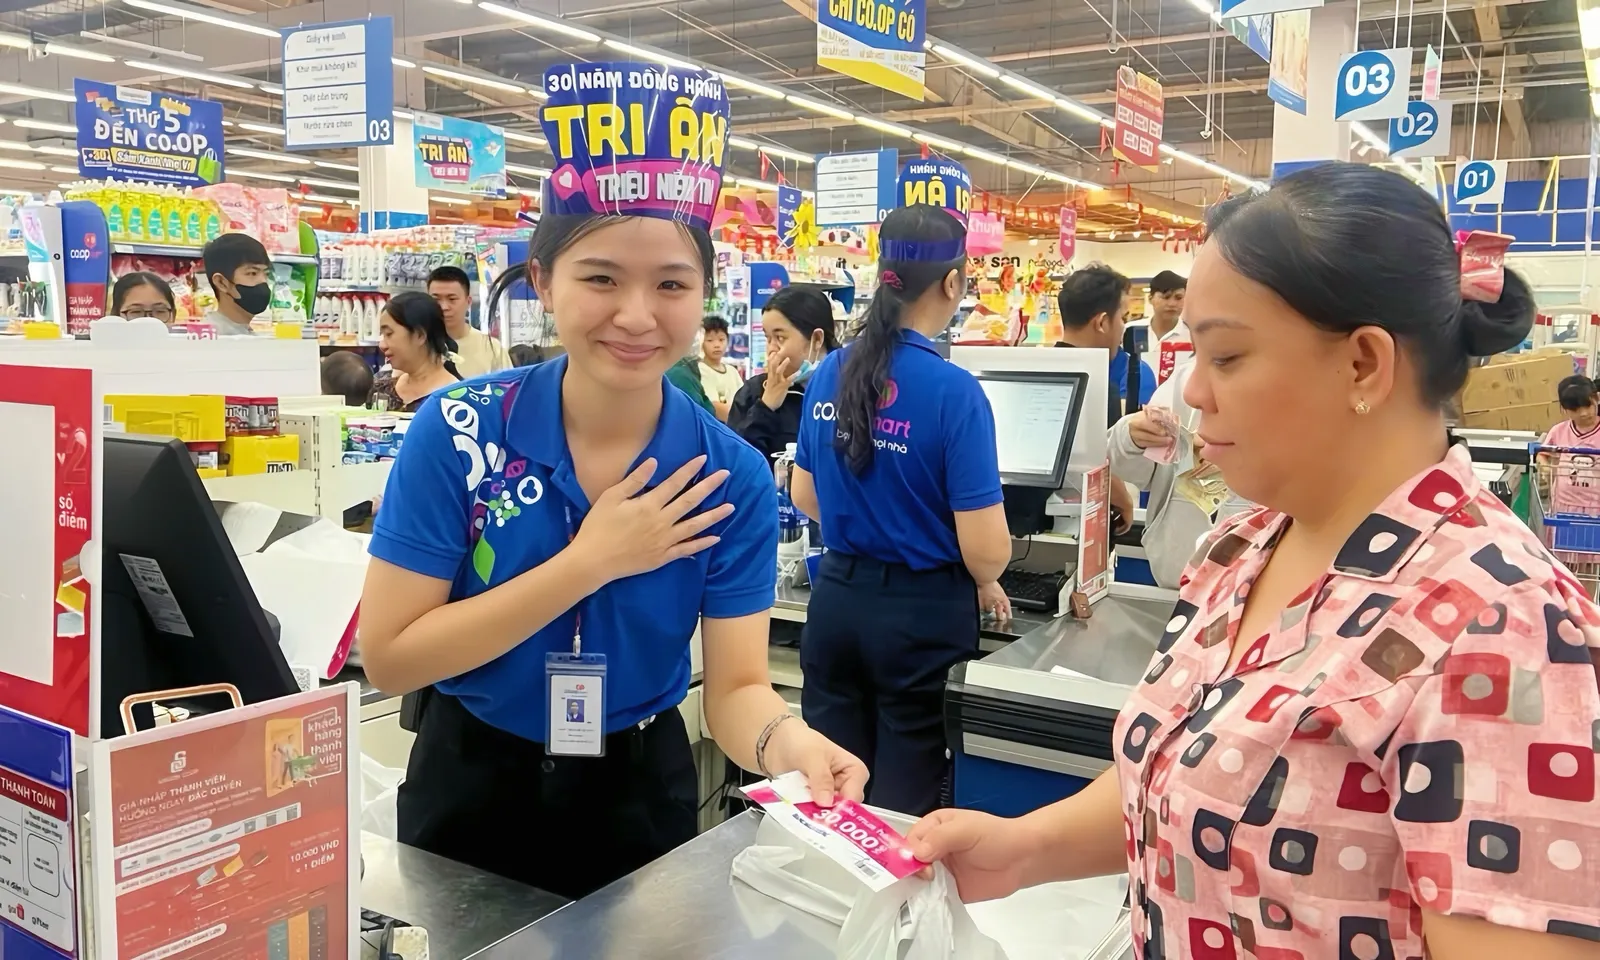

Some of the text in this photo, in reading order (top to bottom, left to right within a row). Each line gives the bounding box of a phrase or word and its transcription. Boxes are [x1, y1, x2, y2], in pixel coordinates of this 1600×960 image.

[897, 9, 916, 43] CÓ
[548, 67, 722, 101] 30 NĂM ĐỒNG HÀNH
[1344, 62, 1390, 97] 03
[125, 106, 181, 133] THỨ 5
[369, 119, 391, 141] 03
[543, 96, 727, 168] TRI ÂN
[1396, 111, 1434, 137] 02
[93, 118, 208, 156] ĐẾN CO.OP
[418, 142, 468, 163] TRI ÂN
[595, 170, 650, 203] TRIỆU
[1463, 169, 1489, 189] 01
[58, 490, 74, 510] số
[58, 506, 88, 531] điểm
[314, 727, 342, 742] hàng
[0, 776, 56, 810] THANH TOÁN
[119, 800, 137, 813] GIA
[169, 780, 203, 797] THÀNH
[203, 773, 227, 786] VIÊN
[812, 809, 880, 849] 30.000
